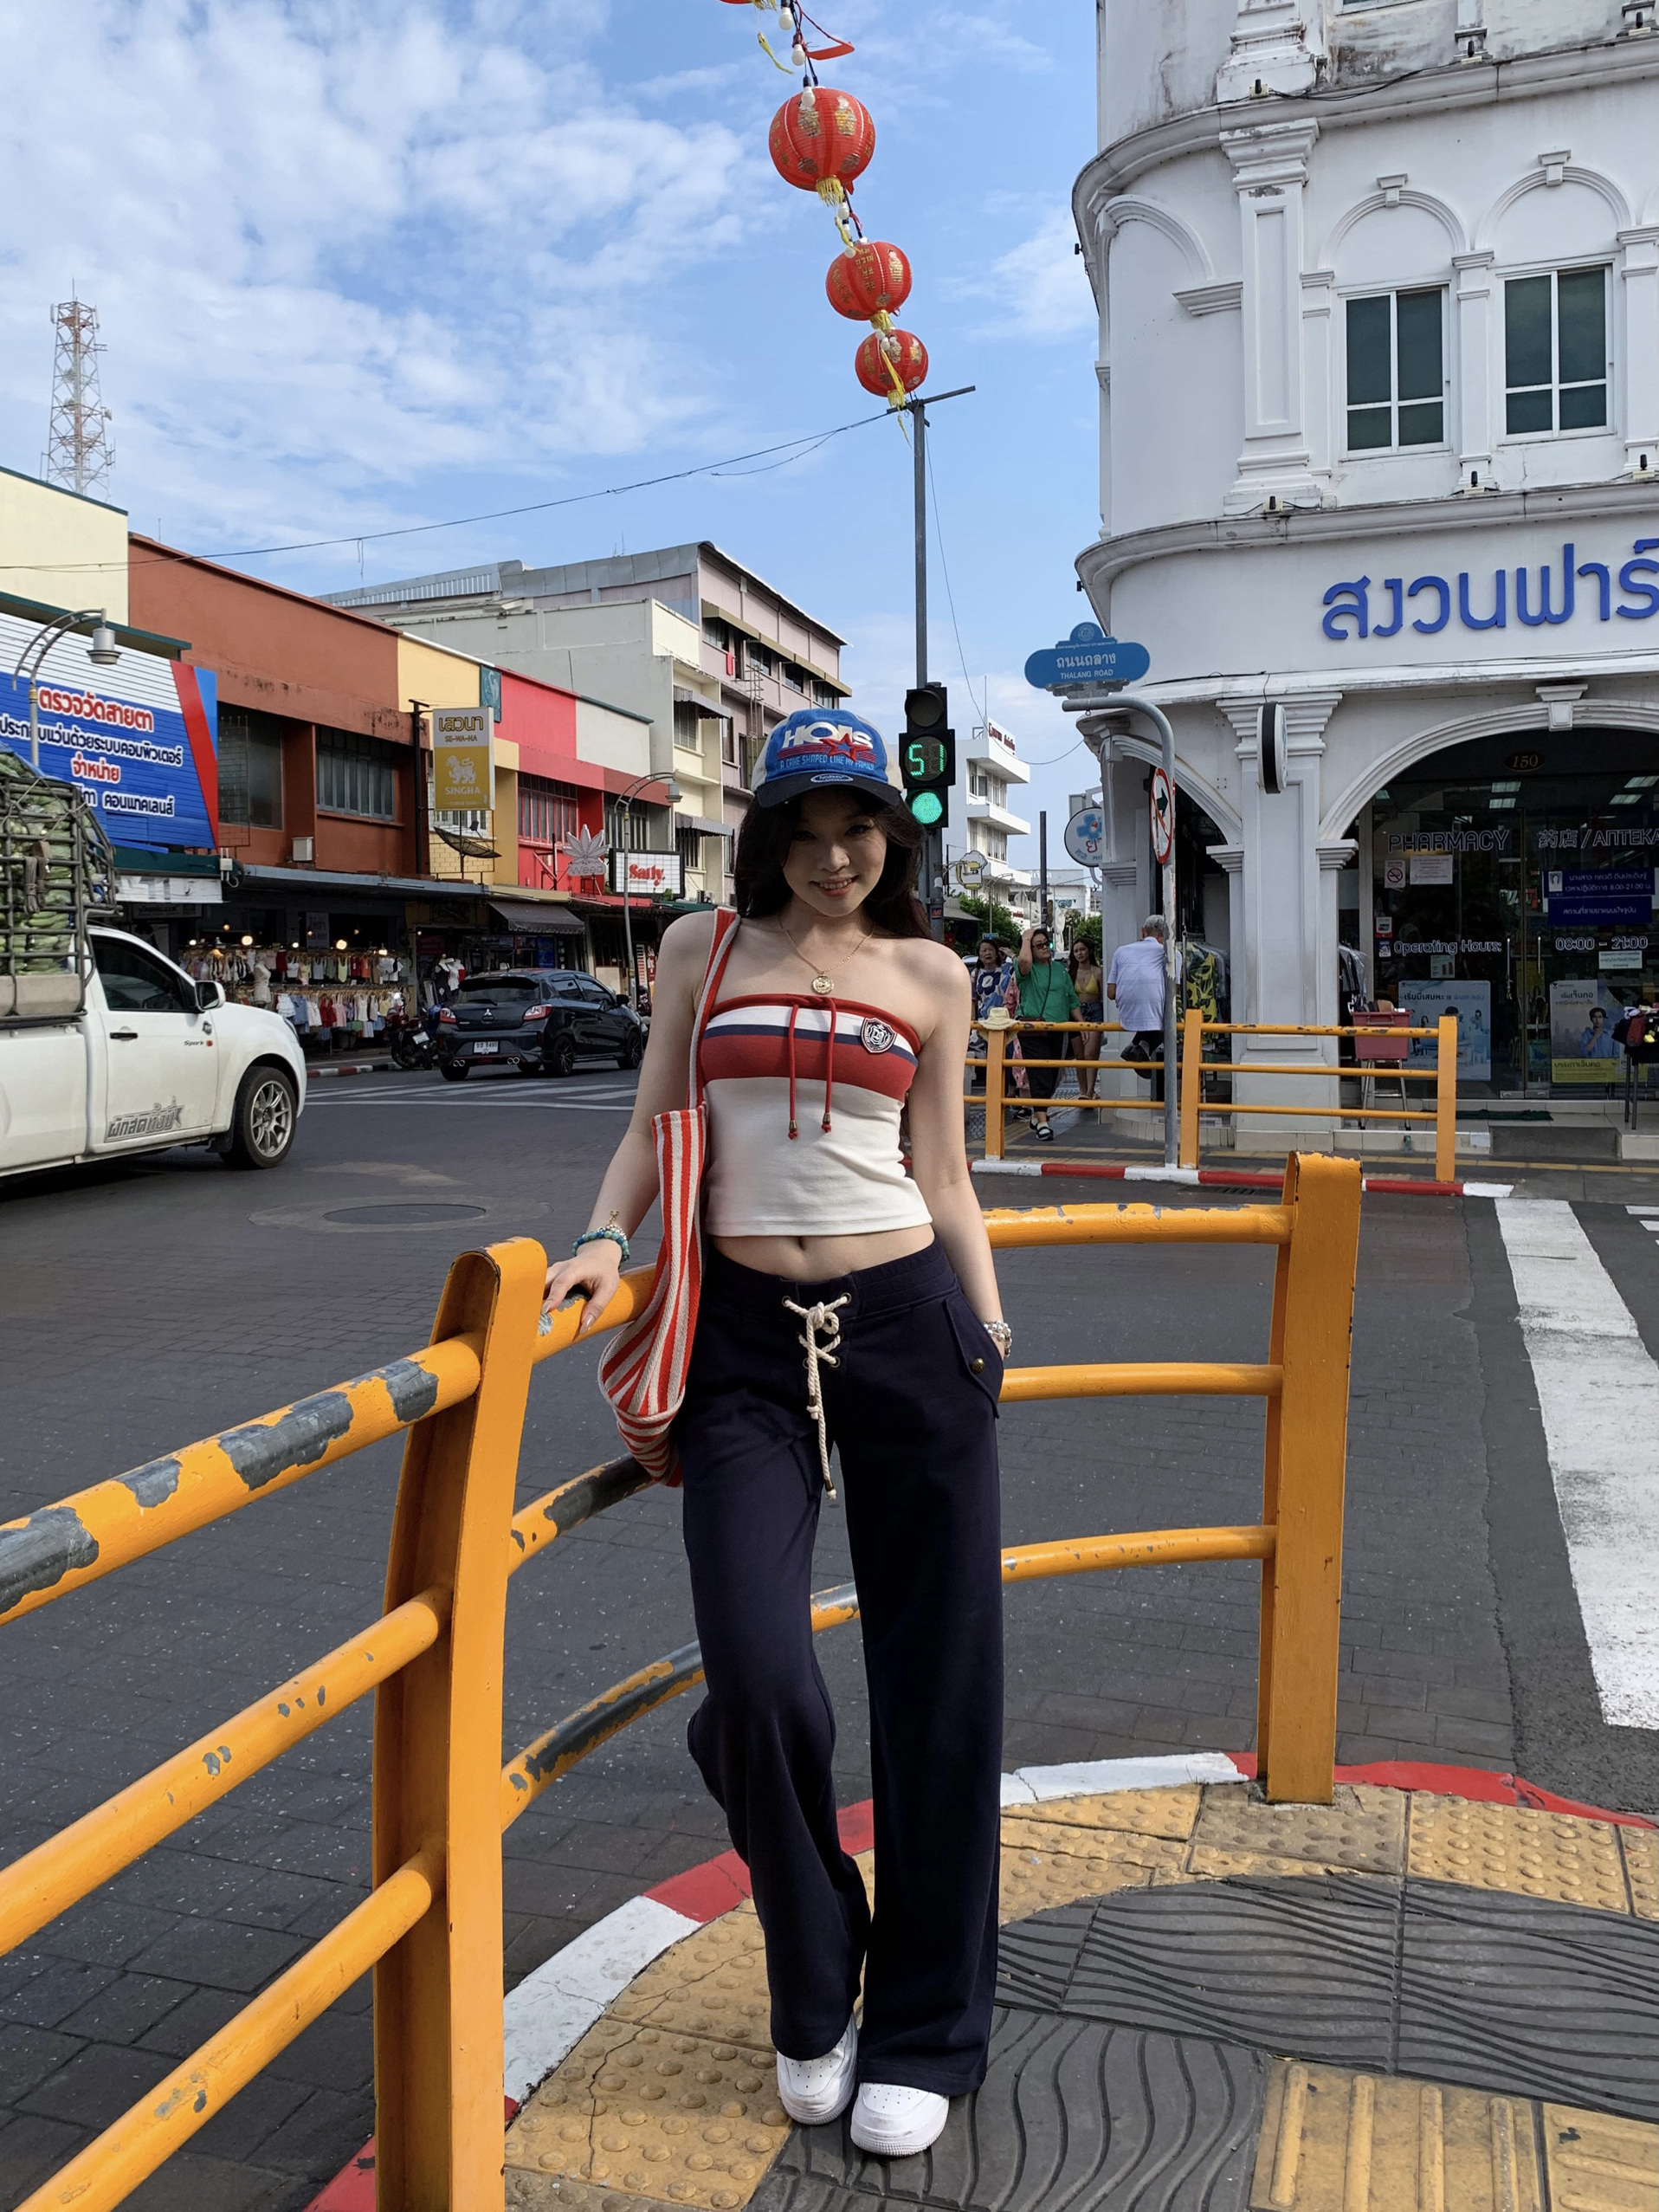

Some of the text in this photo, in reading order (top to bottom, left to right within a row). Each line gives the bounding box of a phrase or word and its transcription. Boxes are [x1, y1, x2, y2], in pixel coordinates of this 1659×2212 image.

[1056, 652, 1116, 669] ถนนถลาง
[1061, 669, 1114, 680] THALANG ROAD
[39, 689, 154, 732] ตรวจวัดสายตา
[439, 715, 484, 732] เสวนา
[0, 717, 182, 765] ประกบแว่นด้วยระบบคอมพิวเตอร์
[72, 754, 120, 782] จำหน่าย
[802, 754, 828, 765] SHAPED
[830, 755, 844, 766] LIKE
[909, 744, 945, 776] 51
[1513, 754, 1539, 768] 150
[445, 786, 481, 795] SINGHA
[104, 792, 174, 817] คอนแทคเลนส์
[1387, 830, 1510, 853] PHARMACY
[1538, 829, 1578, 849] 药店
[1580, 829, 1591, 849] /
[1393, 940, 1458, 955] Operating
[1461, 940, 1502, 953] Hours:
[1555, 936, 1595, 951] 08:00
[1611, 935, 1649, 950] 21:00
